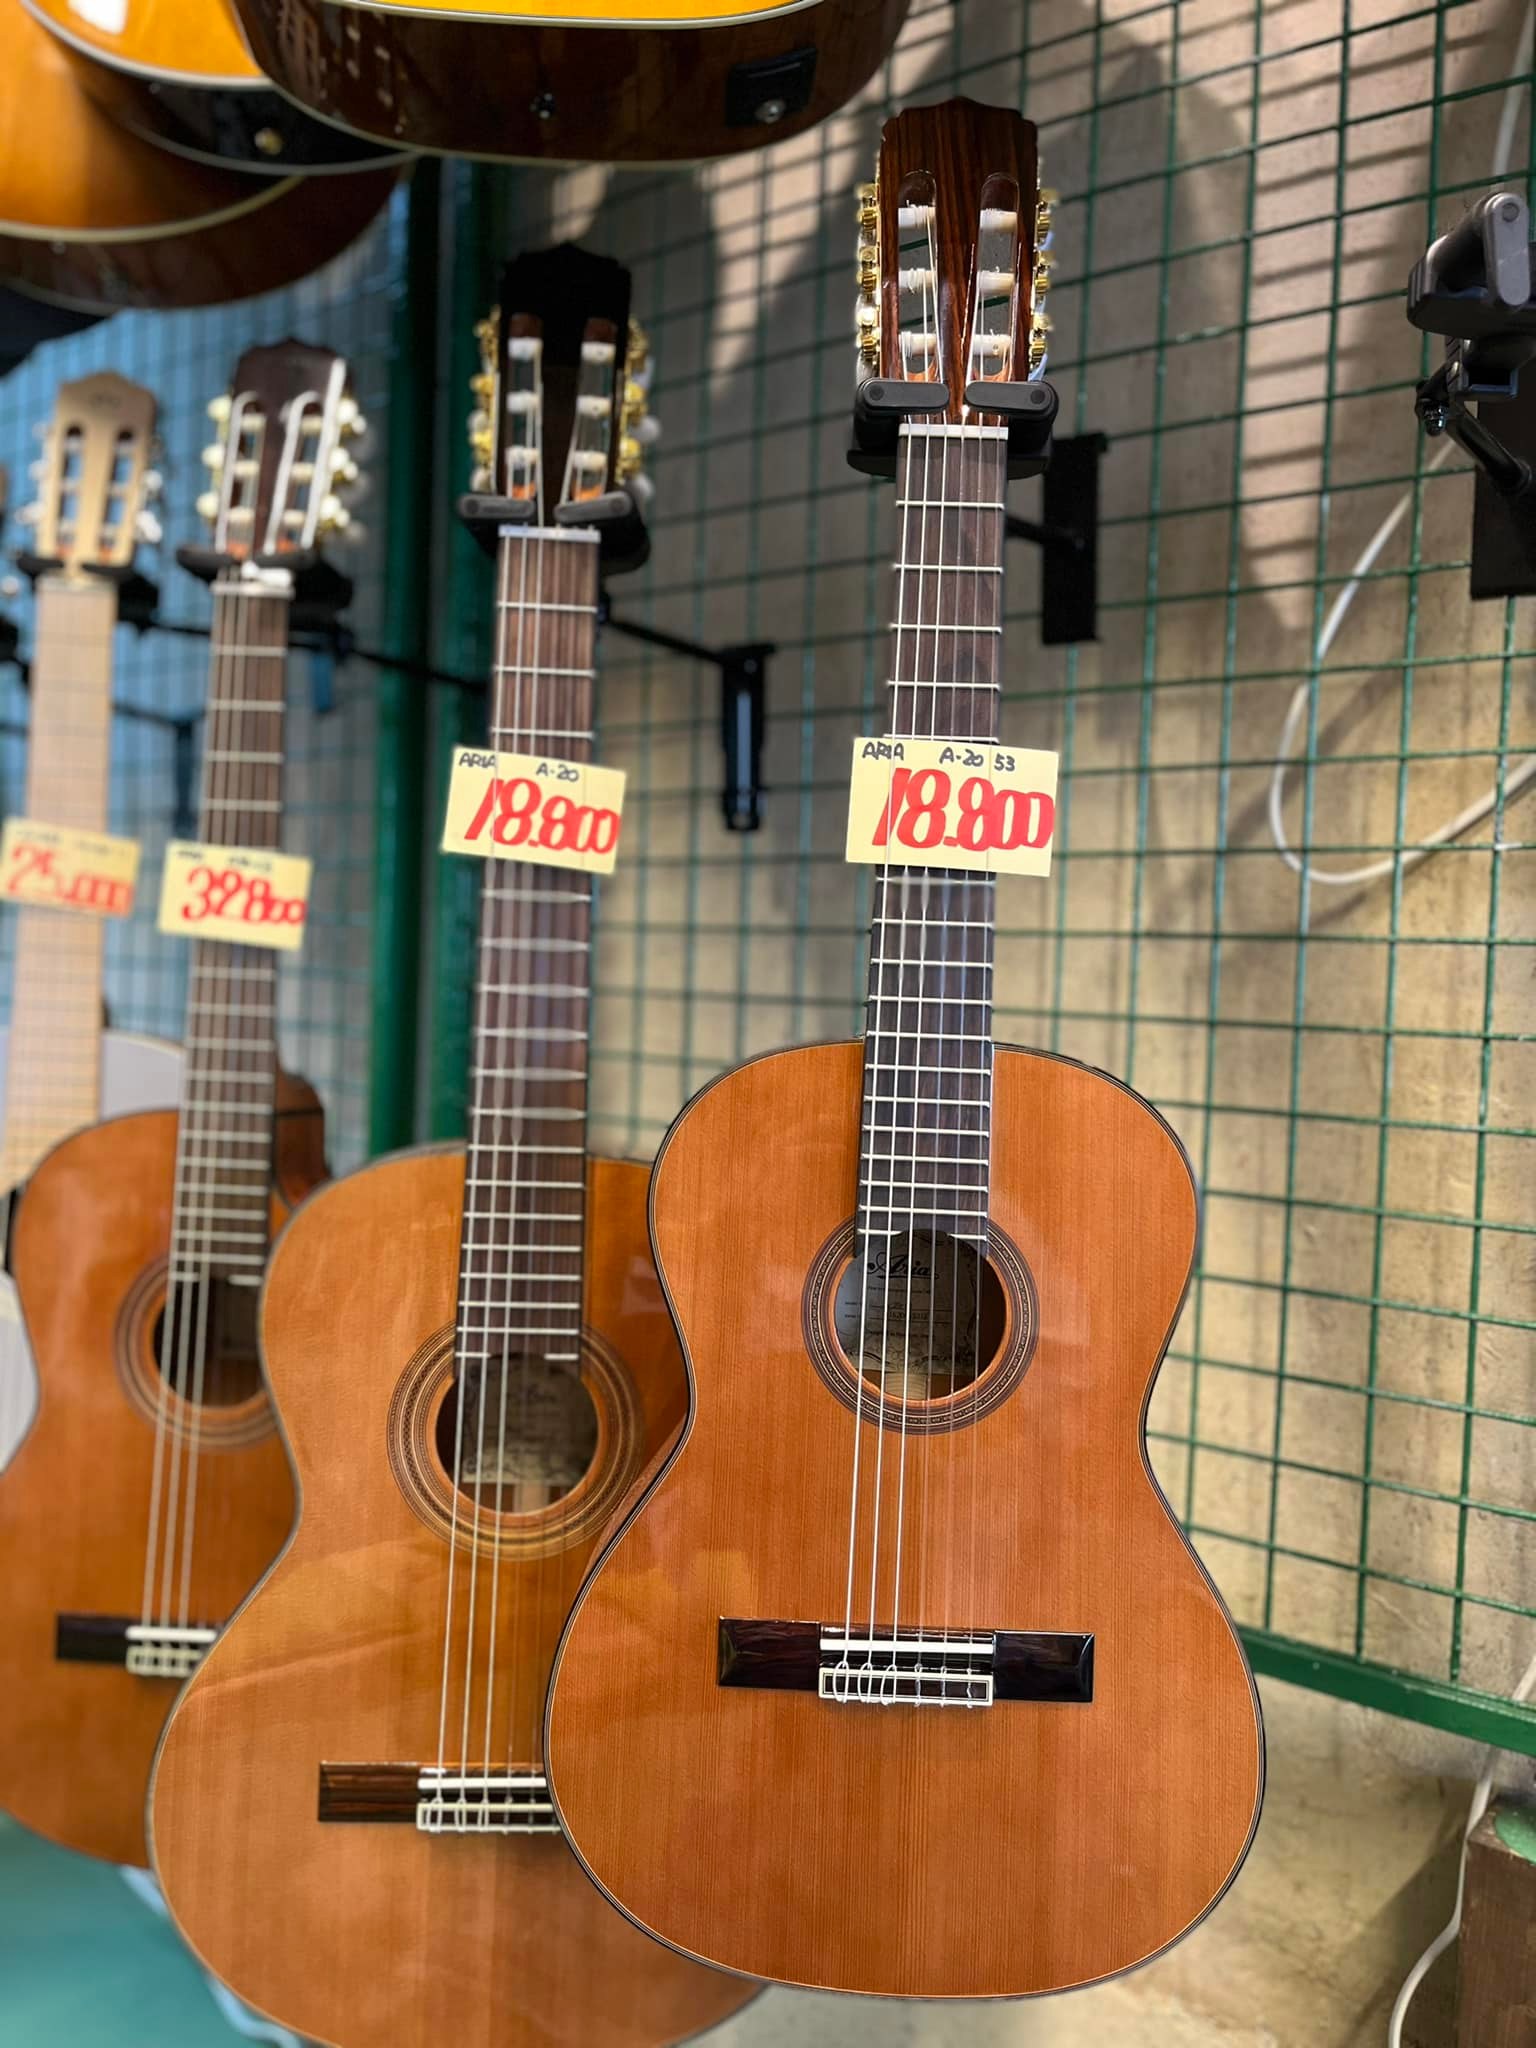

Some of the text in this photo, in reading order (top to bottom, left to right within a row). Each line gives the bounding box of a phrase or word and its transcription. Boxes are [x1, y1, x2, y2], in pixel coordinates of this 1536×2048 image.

[458, 751, 580, 783] ARIA A-20
[862, 741, 1016, 772] ARIA A-20 53
[463, 776, 621, 855] 18.800
[871, 767, 1056, 852] 18.800
